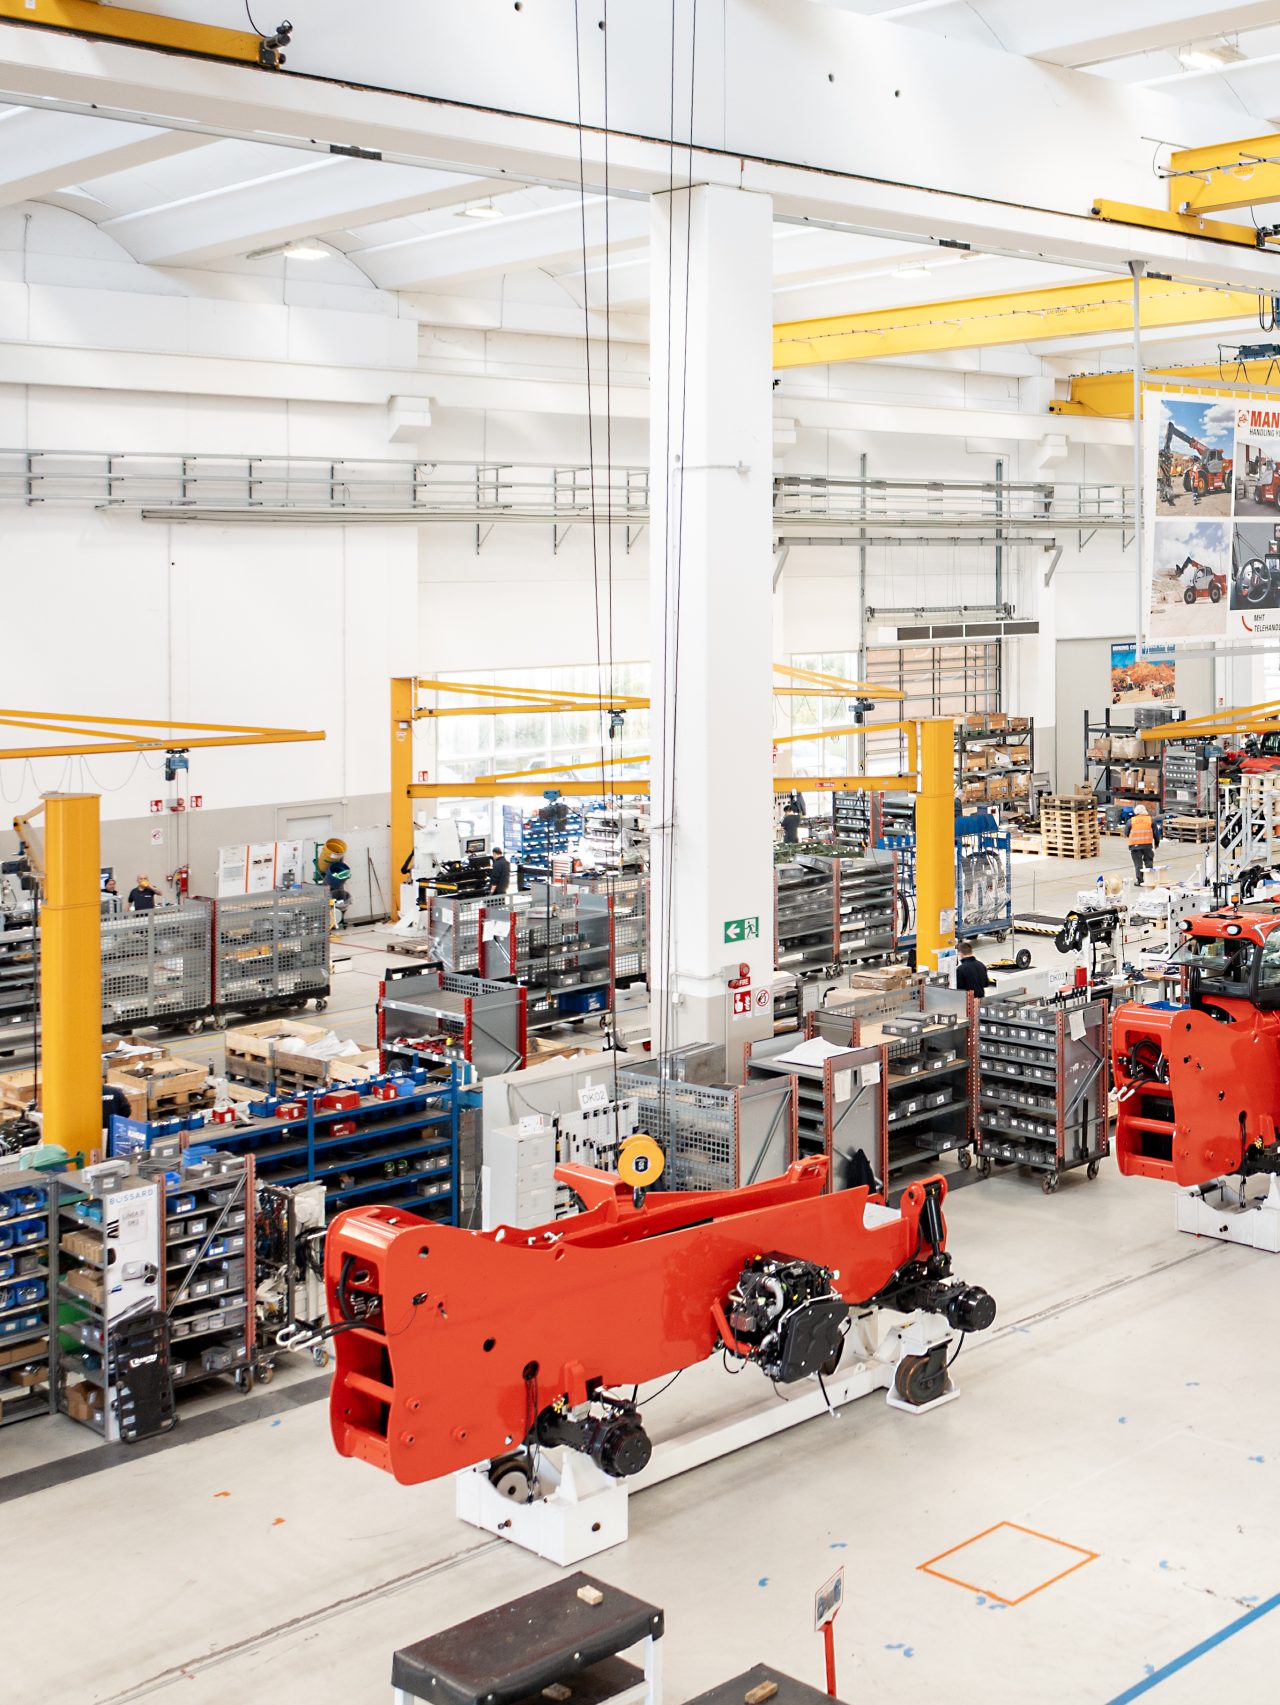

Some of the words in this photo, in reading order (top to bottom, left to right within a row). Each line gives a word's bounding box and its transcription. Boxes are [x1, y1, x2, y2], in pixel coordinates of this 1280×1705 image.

[1249, 428, 1275, 438] HANDLING
[1253, 613, 1266, 622] MHT
[582, 1090, 605, 1105] DK02
